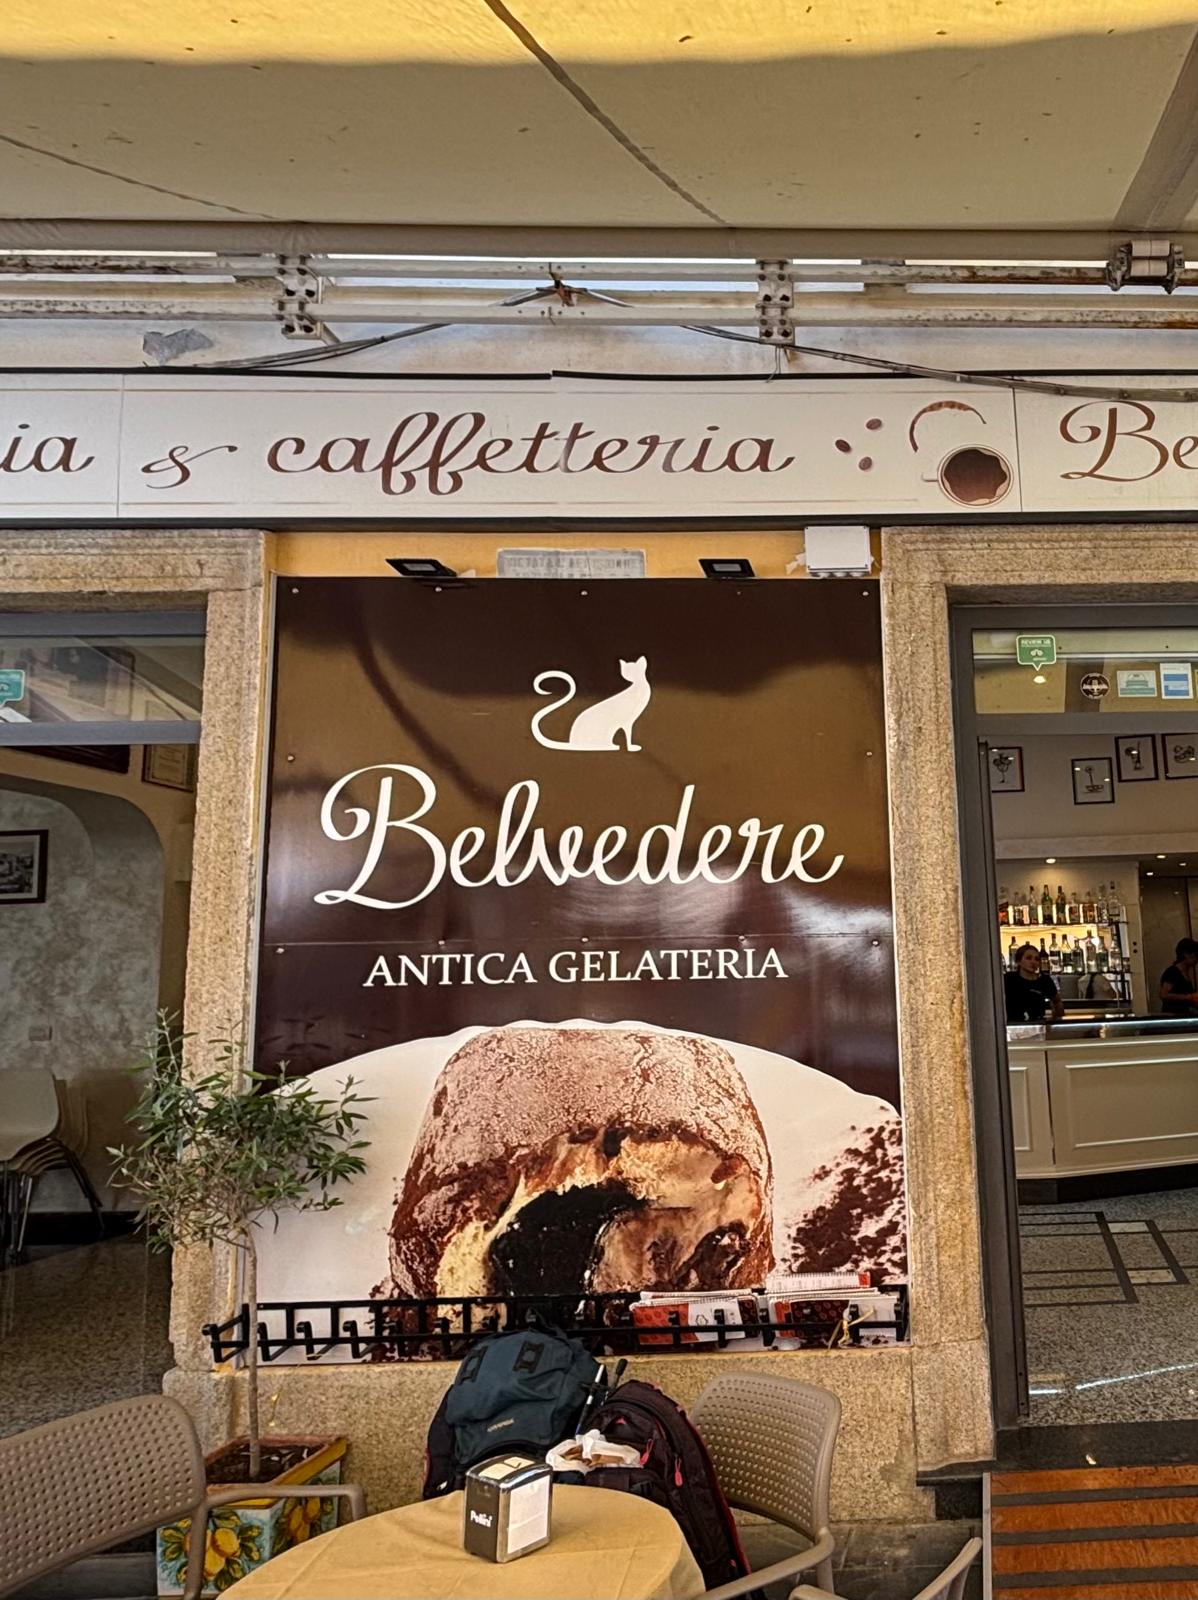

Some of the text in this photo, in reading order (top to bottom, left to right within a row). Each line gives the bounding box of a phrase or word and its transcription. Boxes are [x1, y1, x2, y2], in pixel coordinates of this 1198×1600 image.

[141, 445, 238, 489] &
[267, 411, 796, 496] caffetteria
[1060, 400, 1198, 482] Be
[314, 763, 844, 909] Belvedere
[363, 947, 789, 987] ANTICA GELATERIA
